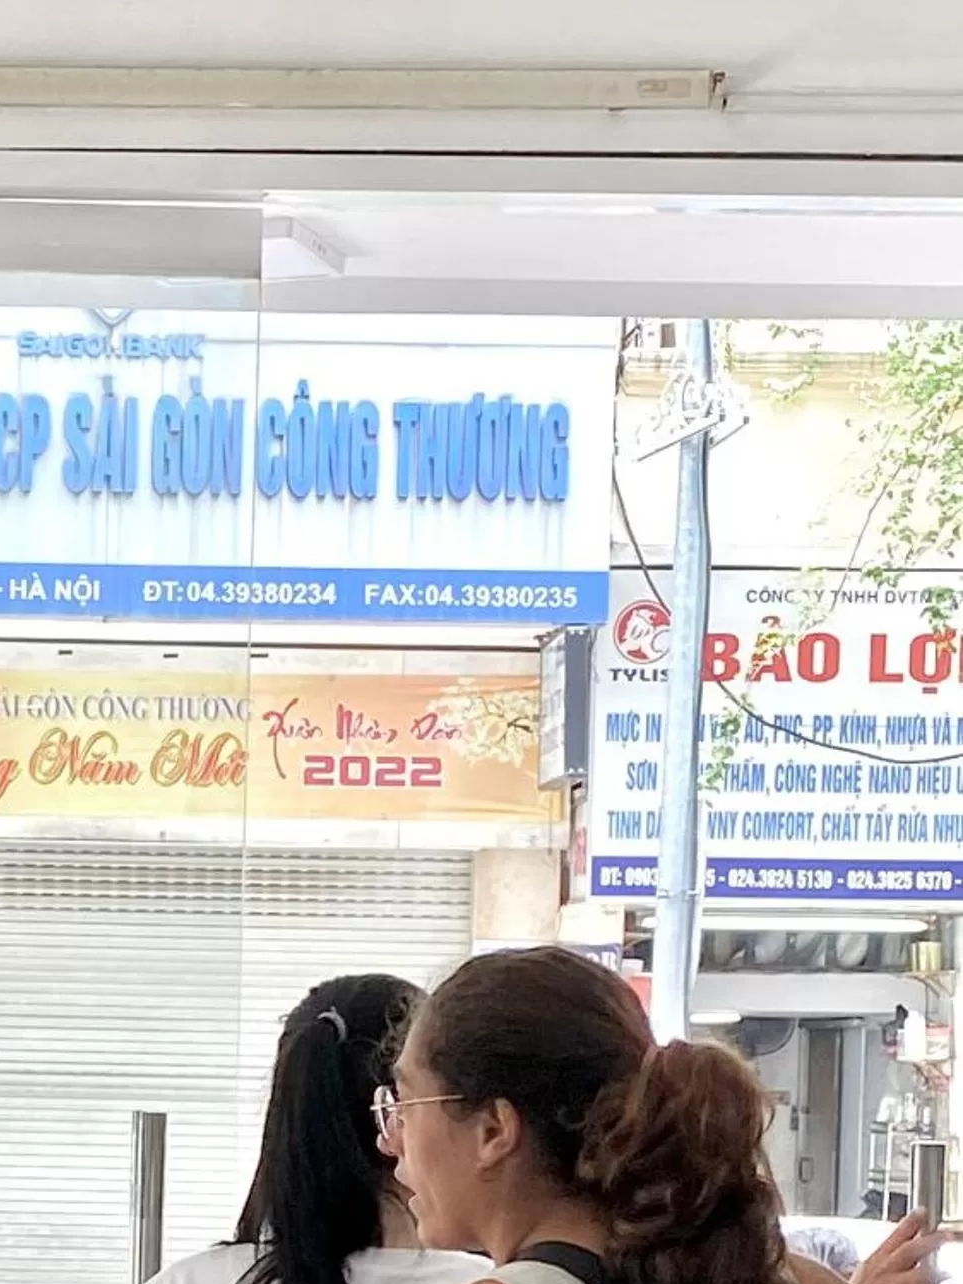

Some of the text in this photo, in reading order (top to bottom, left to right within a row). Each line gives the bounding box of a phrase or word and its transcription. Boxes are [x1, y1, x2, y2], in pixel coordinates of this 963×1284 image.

[62, 375, 139, 497] SÀI
[151, 375, 244, 499] GÒN
[256, 379, 380, 501] CÔNG
[393, 392, 569, 503] THƯƠNG
[9, 572, 47, 601] HÀ
[54, 574, 100, 607] NỘI
[364, 583, 578, 608] FAX:04.39380235
[869, 626, 963, 694] LỢ
[82, 688, 146, 721] CÔNG
[645, 713, 663, 742] IN
[303, 755, 443, 787] 2022
[625, 758, 658, 791] SƠN
[774, 759, 816, 794] CÔNG
[868, 765, 912, 794] NANO
[607, 811, 642, 840] TINH
